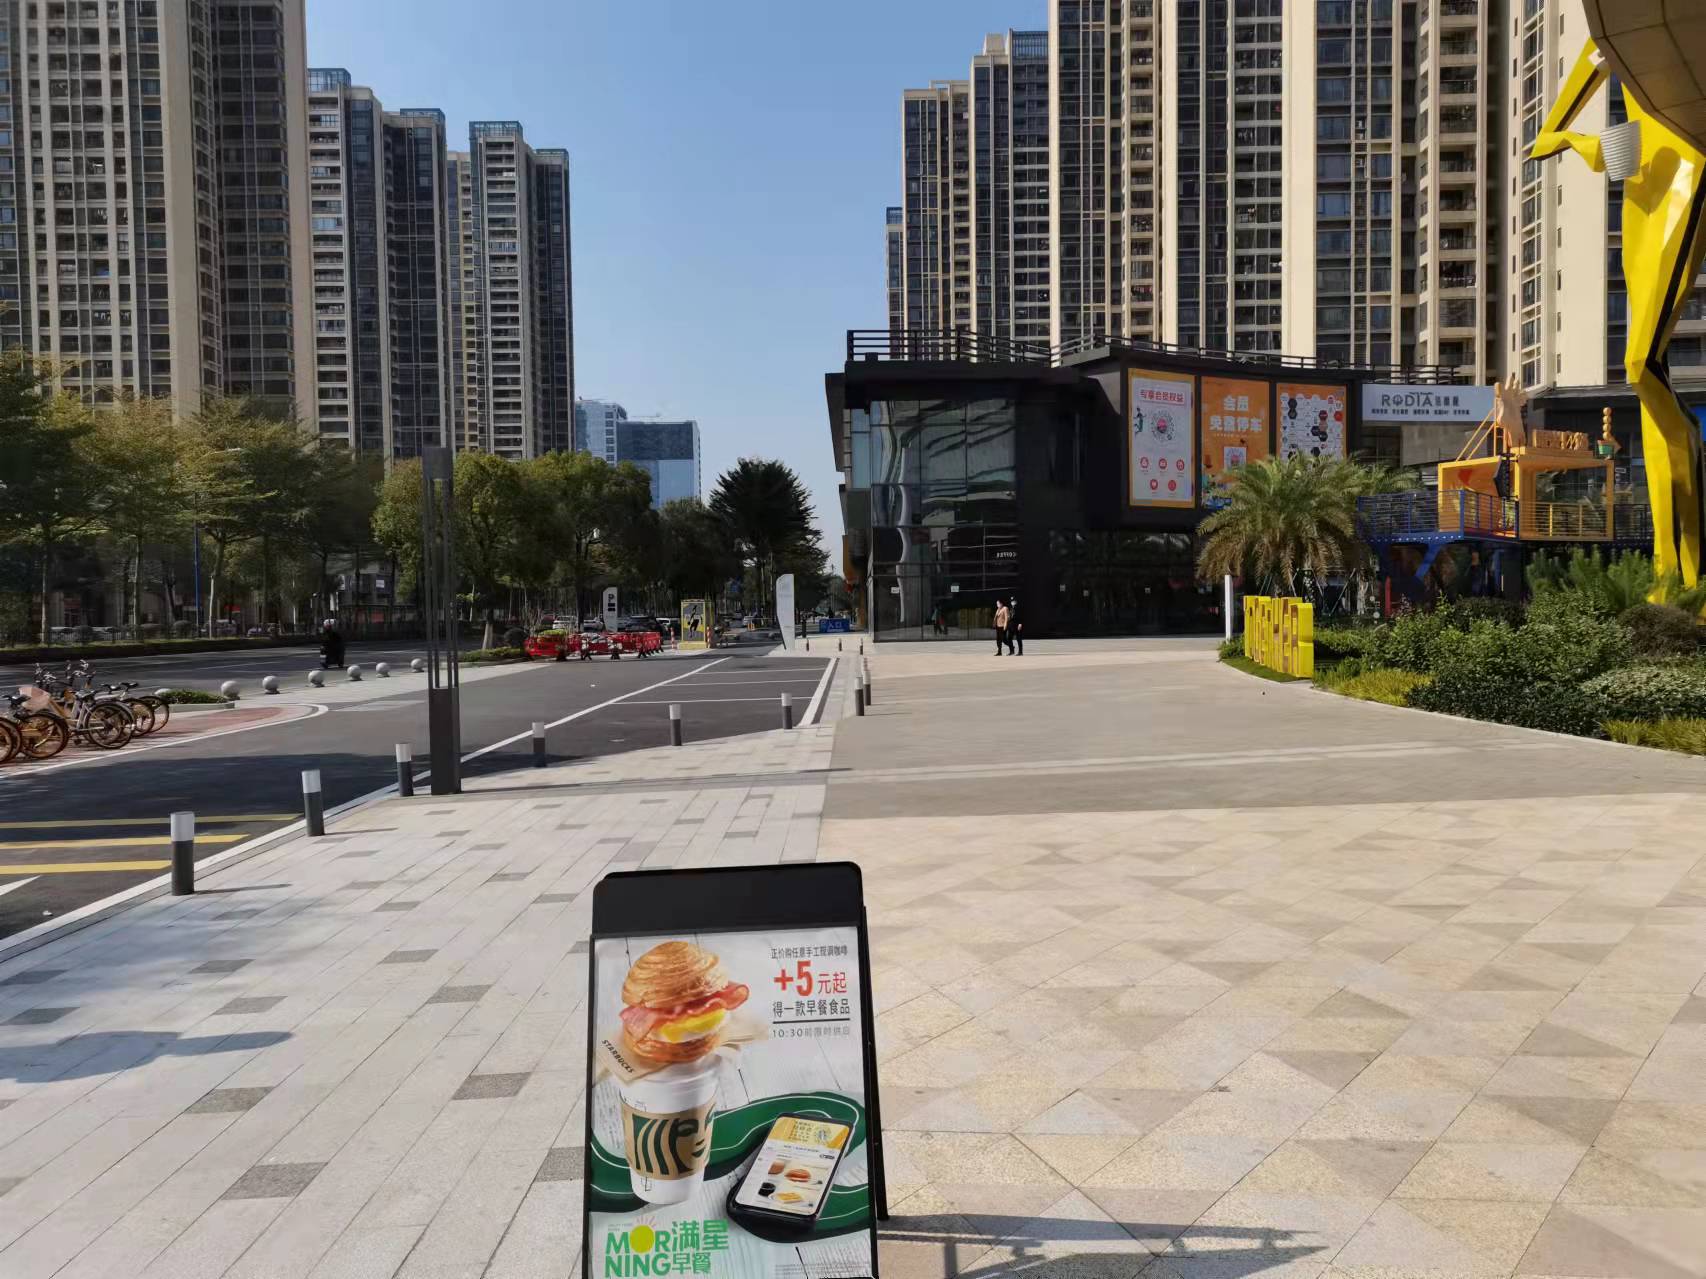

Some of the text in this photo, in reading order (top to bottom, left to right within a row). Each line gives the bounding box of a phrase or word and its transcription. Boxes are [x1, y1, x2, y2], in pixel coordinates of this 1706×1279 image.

[772, 998, 850, 1018] 得一款早餐食品
[601, 1039, 635, 1074] STARBUCKS
[605, 1252, 711, 1278] NING 早餐
